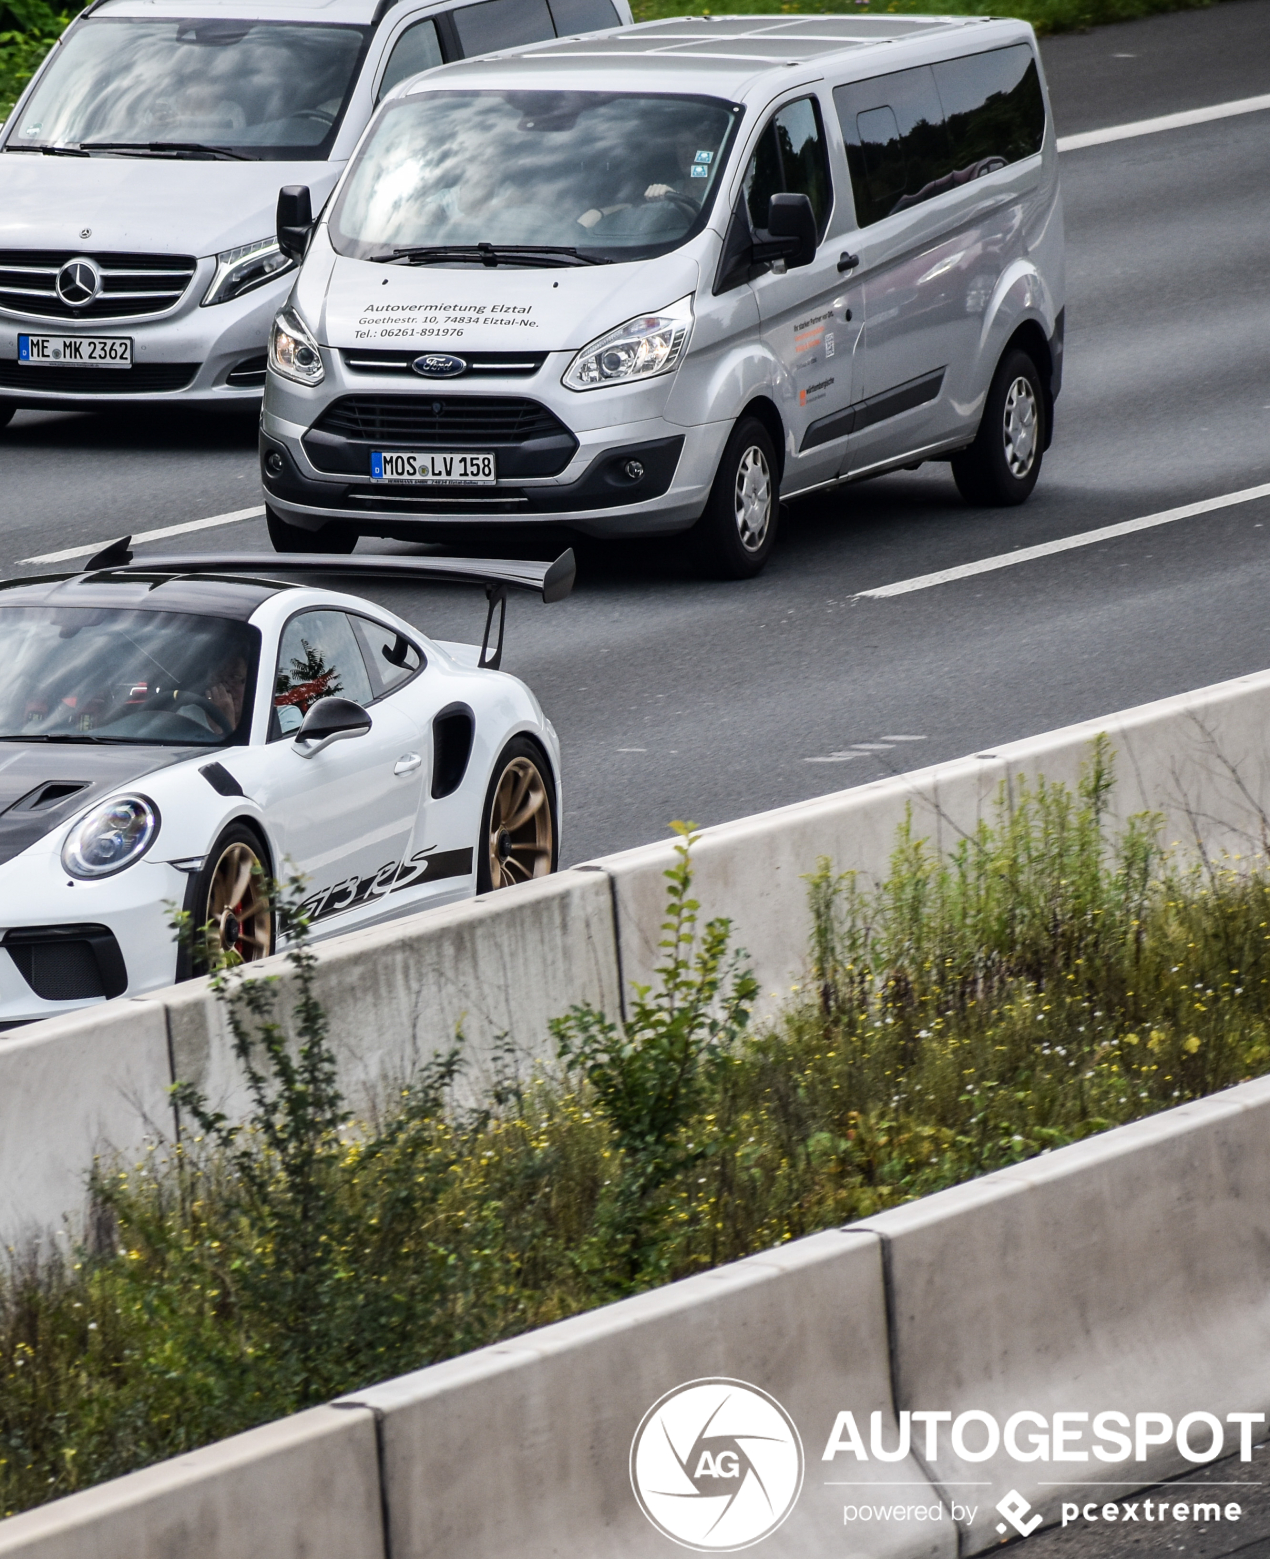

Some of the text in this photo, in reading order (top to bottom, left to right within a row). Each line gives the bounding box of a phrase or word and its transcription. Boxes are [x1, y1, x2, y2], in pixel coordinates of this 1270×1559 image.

[363, 302, 532, 315] Autovermietung Elztal
[358, 316, 540, 328] Goethestr. 10, 74834 Elztal-Ne.
[354, 328, 464, 339] Tel.: 06261-891976
[30, 339, 50, 358] ME
[63, 340, 83, 360] MK
[88, 341, 129, 360] 2362
[422, 357, 453, 370] Ford
[383, 455, 417, 476] MOS
[431, 456, 454, 477] LV
[458, 457, 492, 477] 158
[363, 844, 438, 900] RS
